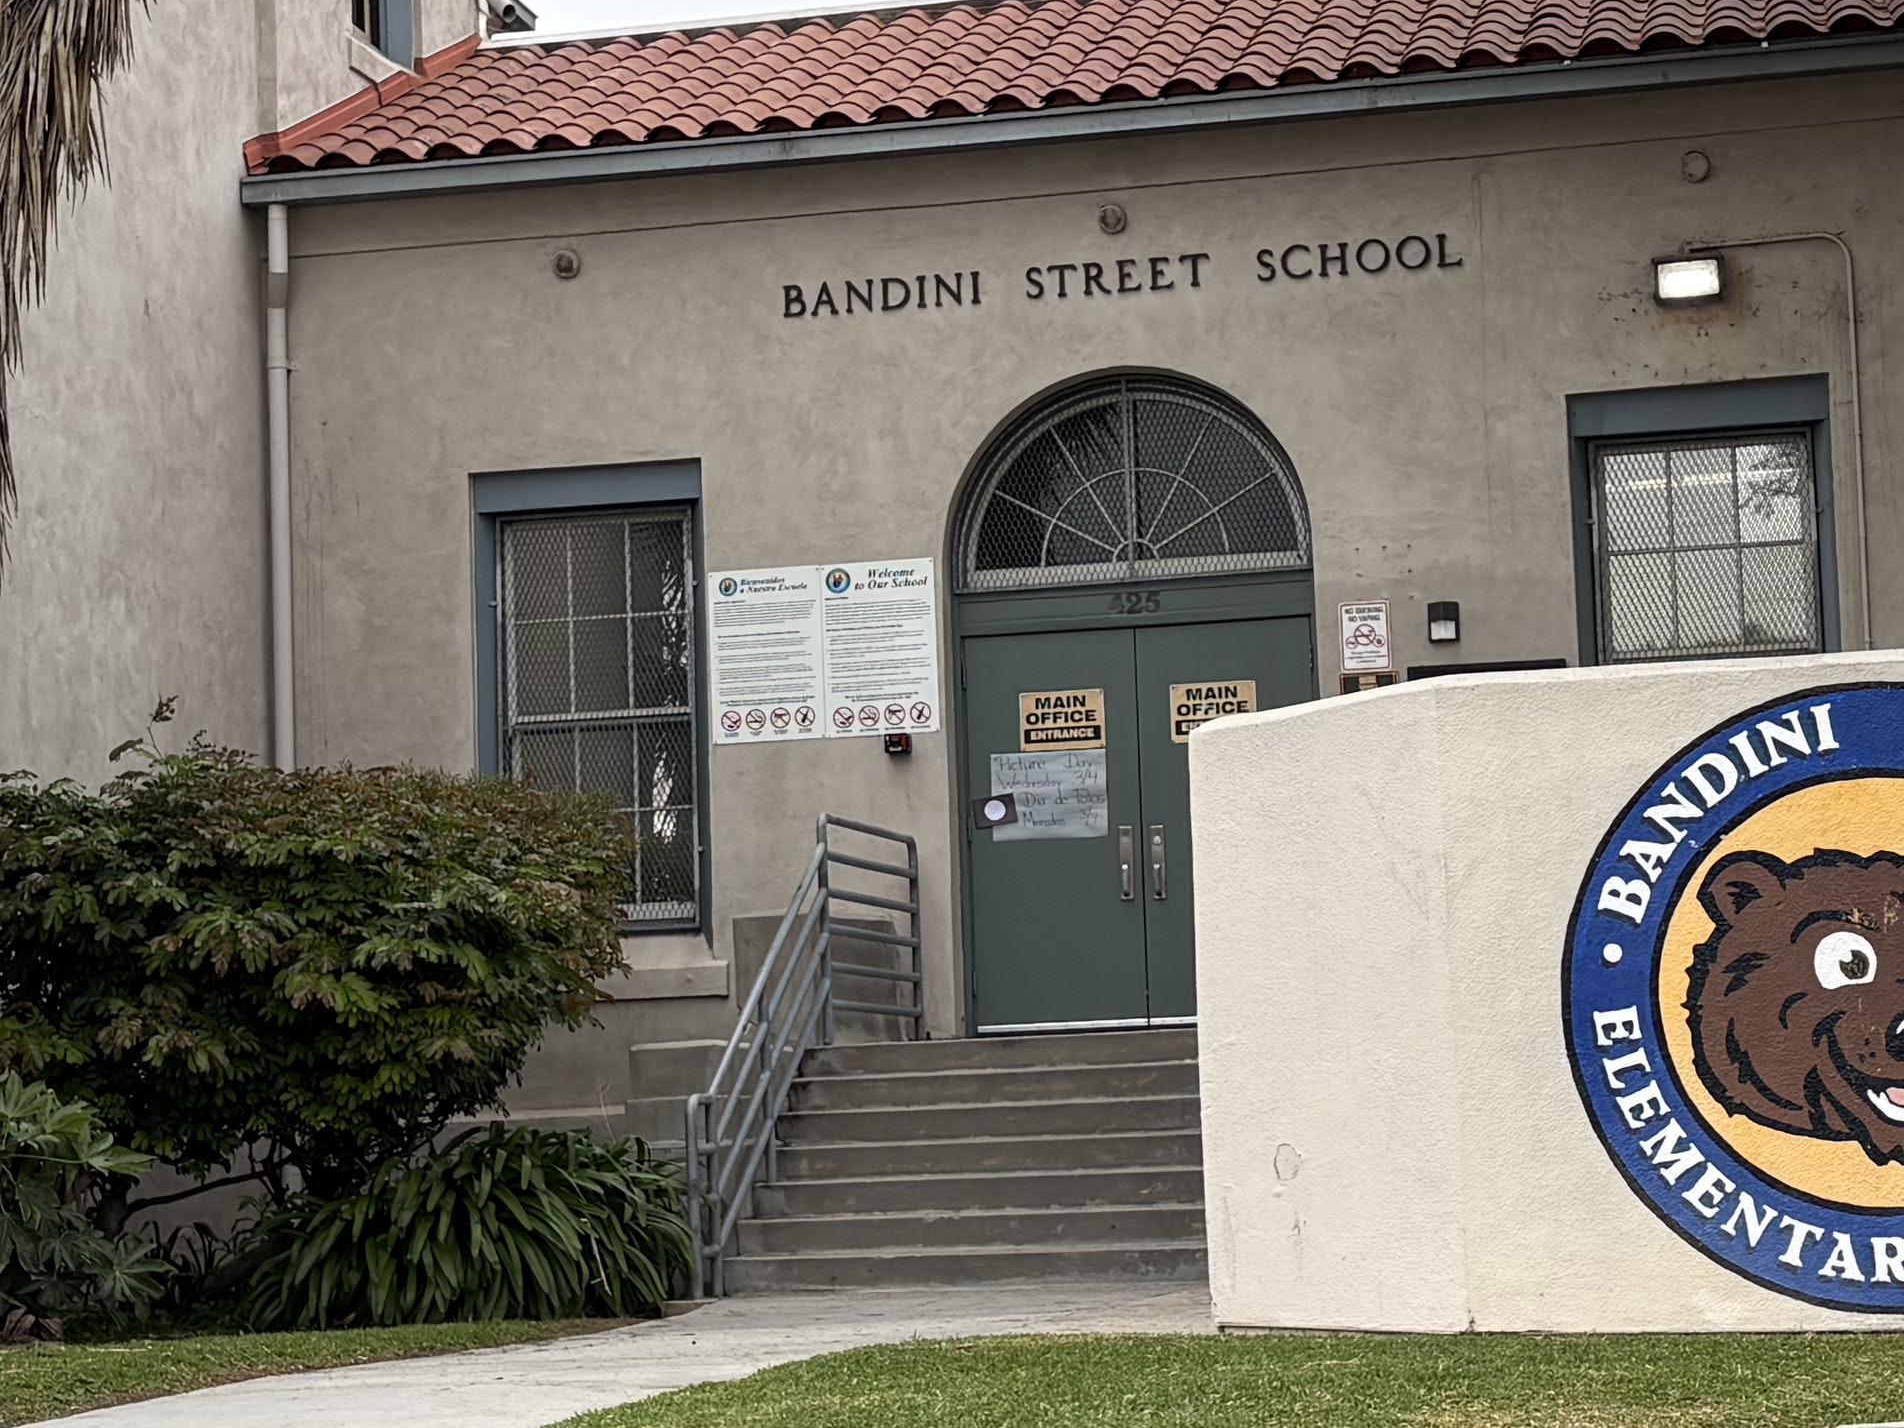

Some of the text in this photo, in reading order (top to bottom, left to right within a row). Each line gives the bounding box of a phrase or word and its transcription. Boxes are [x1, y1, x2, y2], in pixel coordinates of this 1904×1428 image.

[782, 233, 1464, 319] BANDINI STREET SCHOOL
[868, 568, 915, 579] Welcome
[854, 576, 928, 591] to Our School
[1108, 591, 1161, 615] 425
[1185, 686, 1238, 701] MAIN
[1034, 695, 1086, 710] MAIN
[1177, 701, 1249, 716] OFFICE
[1025, 709, 1097, 725] OFFICE
[1030, 727, 1095, 741] ENTRANCE
[1596, 702, 1840, 925] BANDINI
